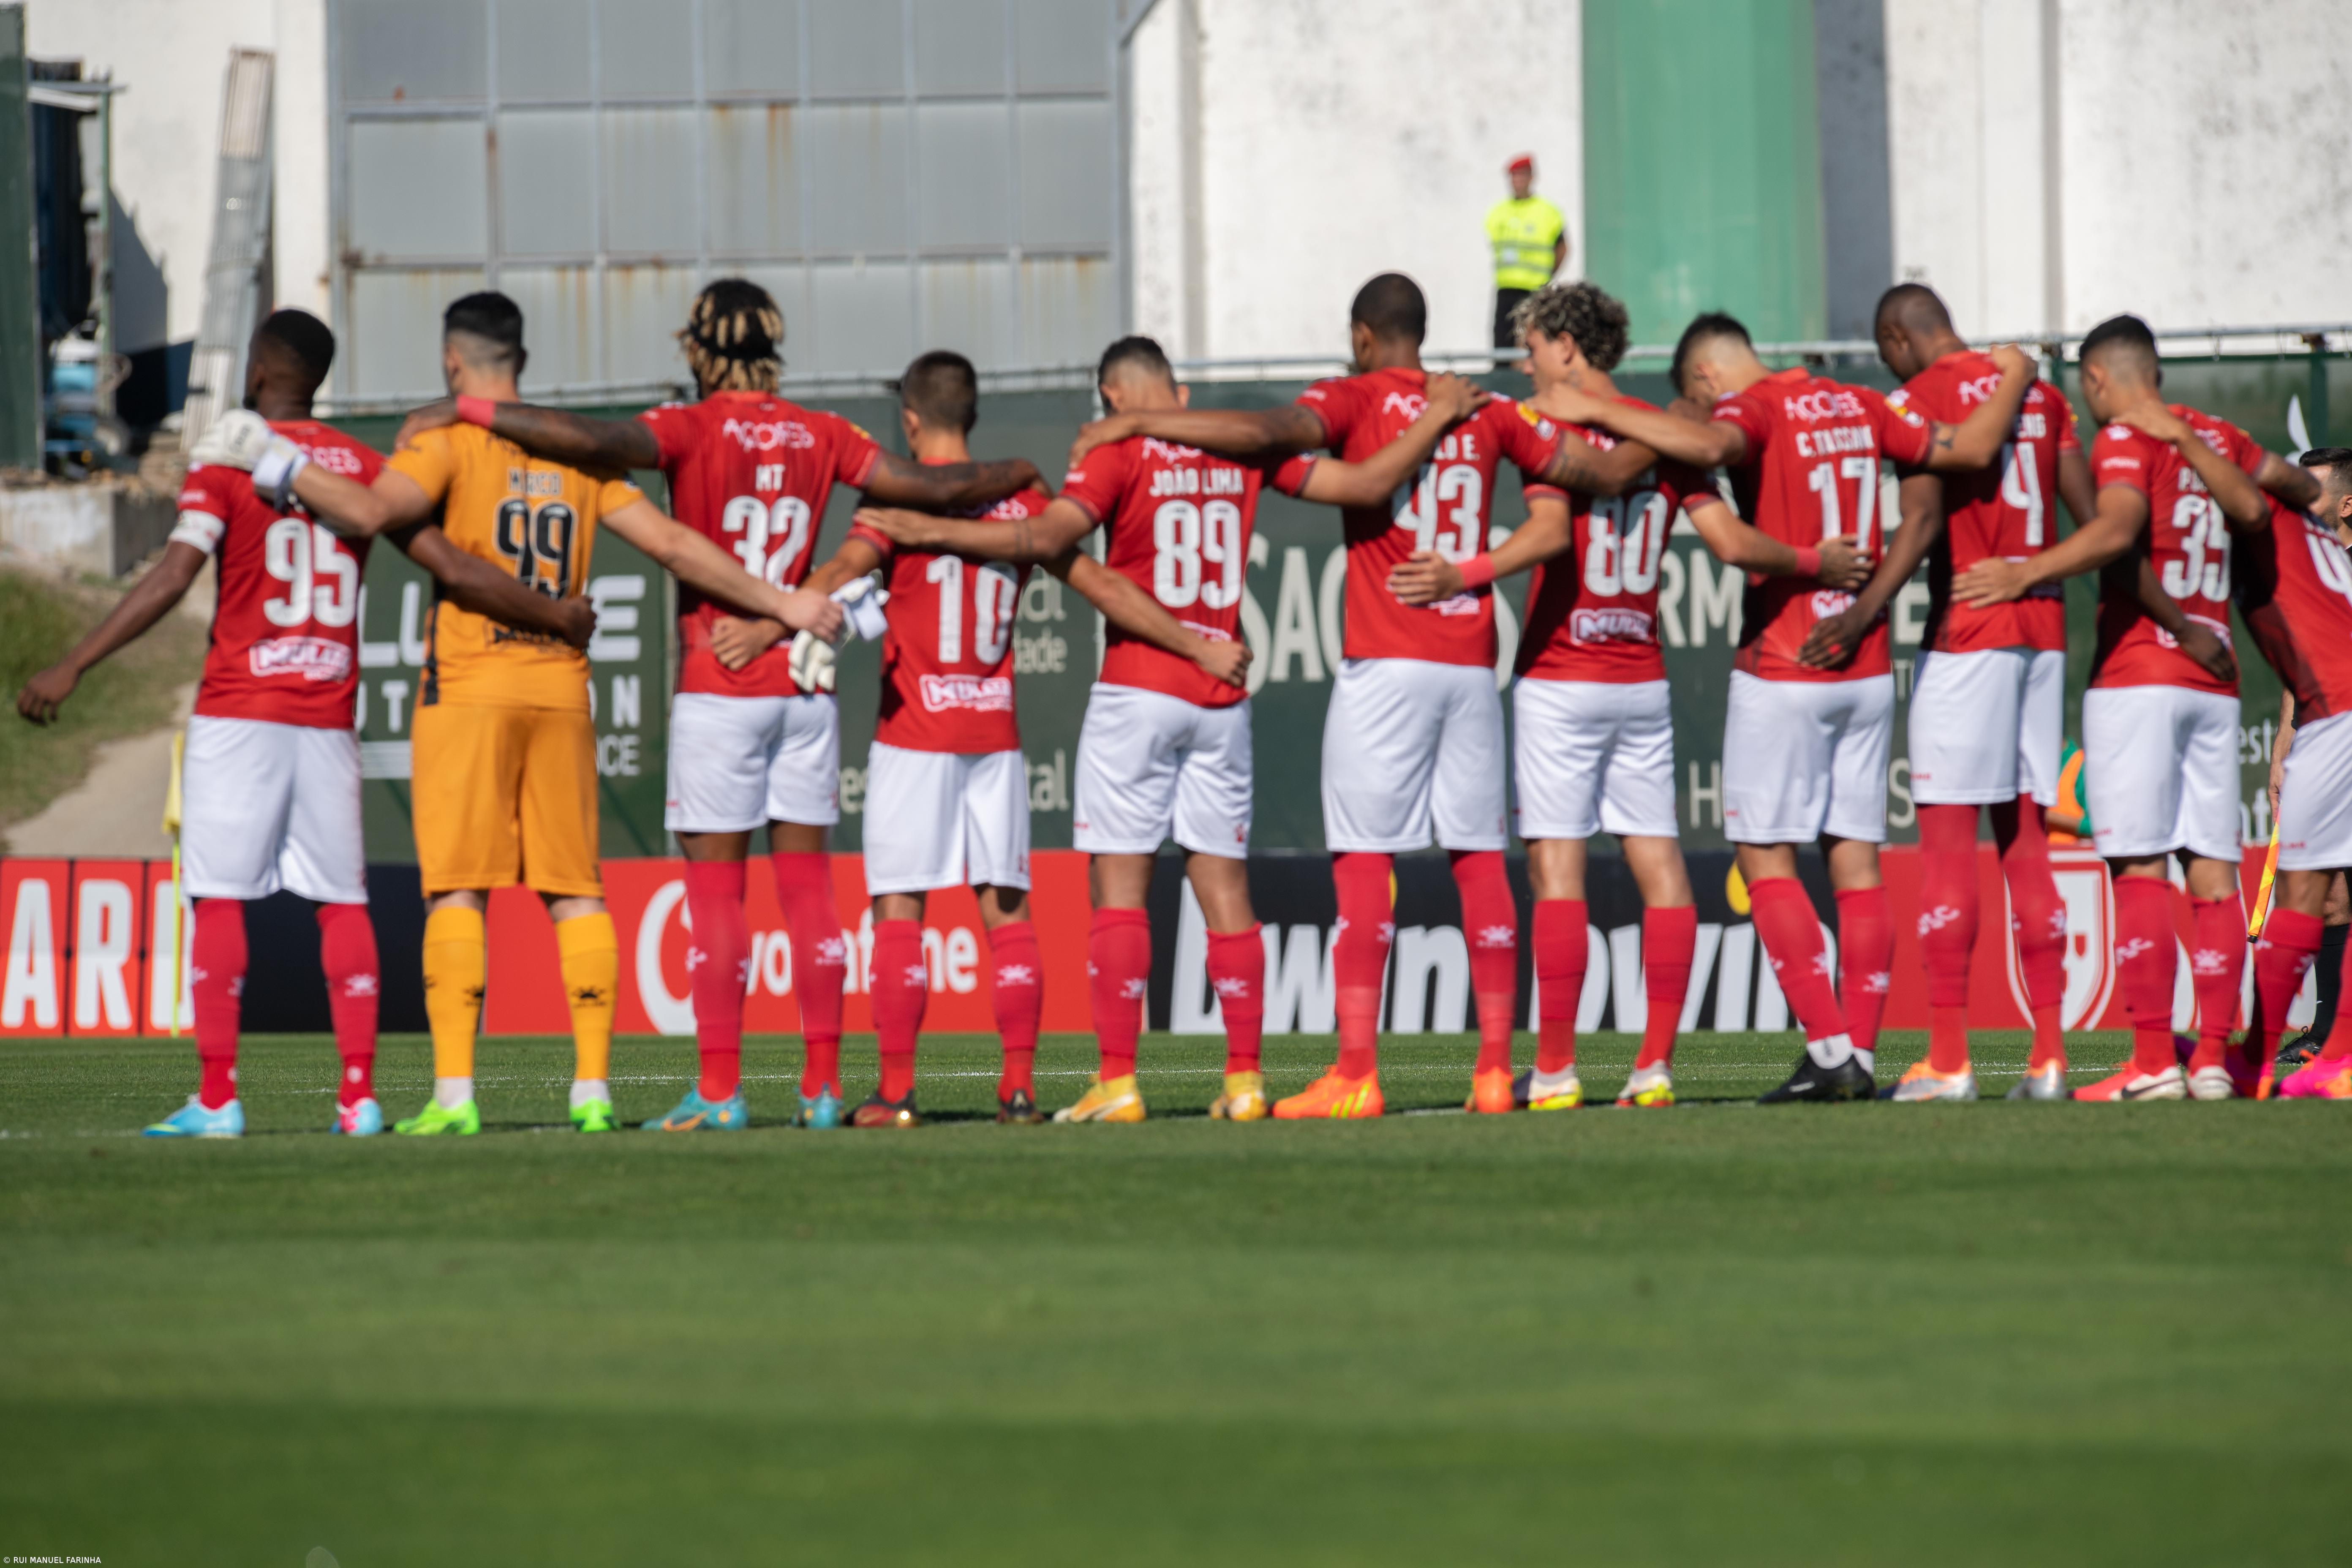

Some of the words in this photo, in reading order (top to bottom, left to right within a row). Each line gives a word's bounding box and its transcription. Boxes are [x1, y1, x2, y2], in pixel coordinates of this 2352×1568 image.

[1148, 464, 1198, 497] JOÃO
[1808, 456, 1876, 564] 17
[264, 517, 358, 627] 95
[494, 498, 577, 601] 99
[721, 495, 811, 591] 32
[1153, 499, 1242, 610] 89
[926, 554, 1019, 665] 10
